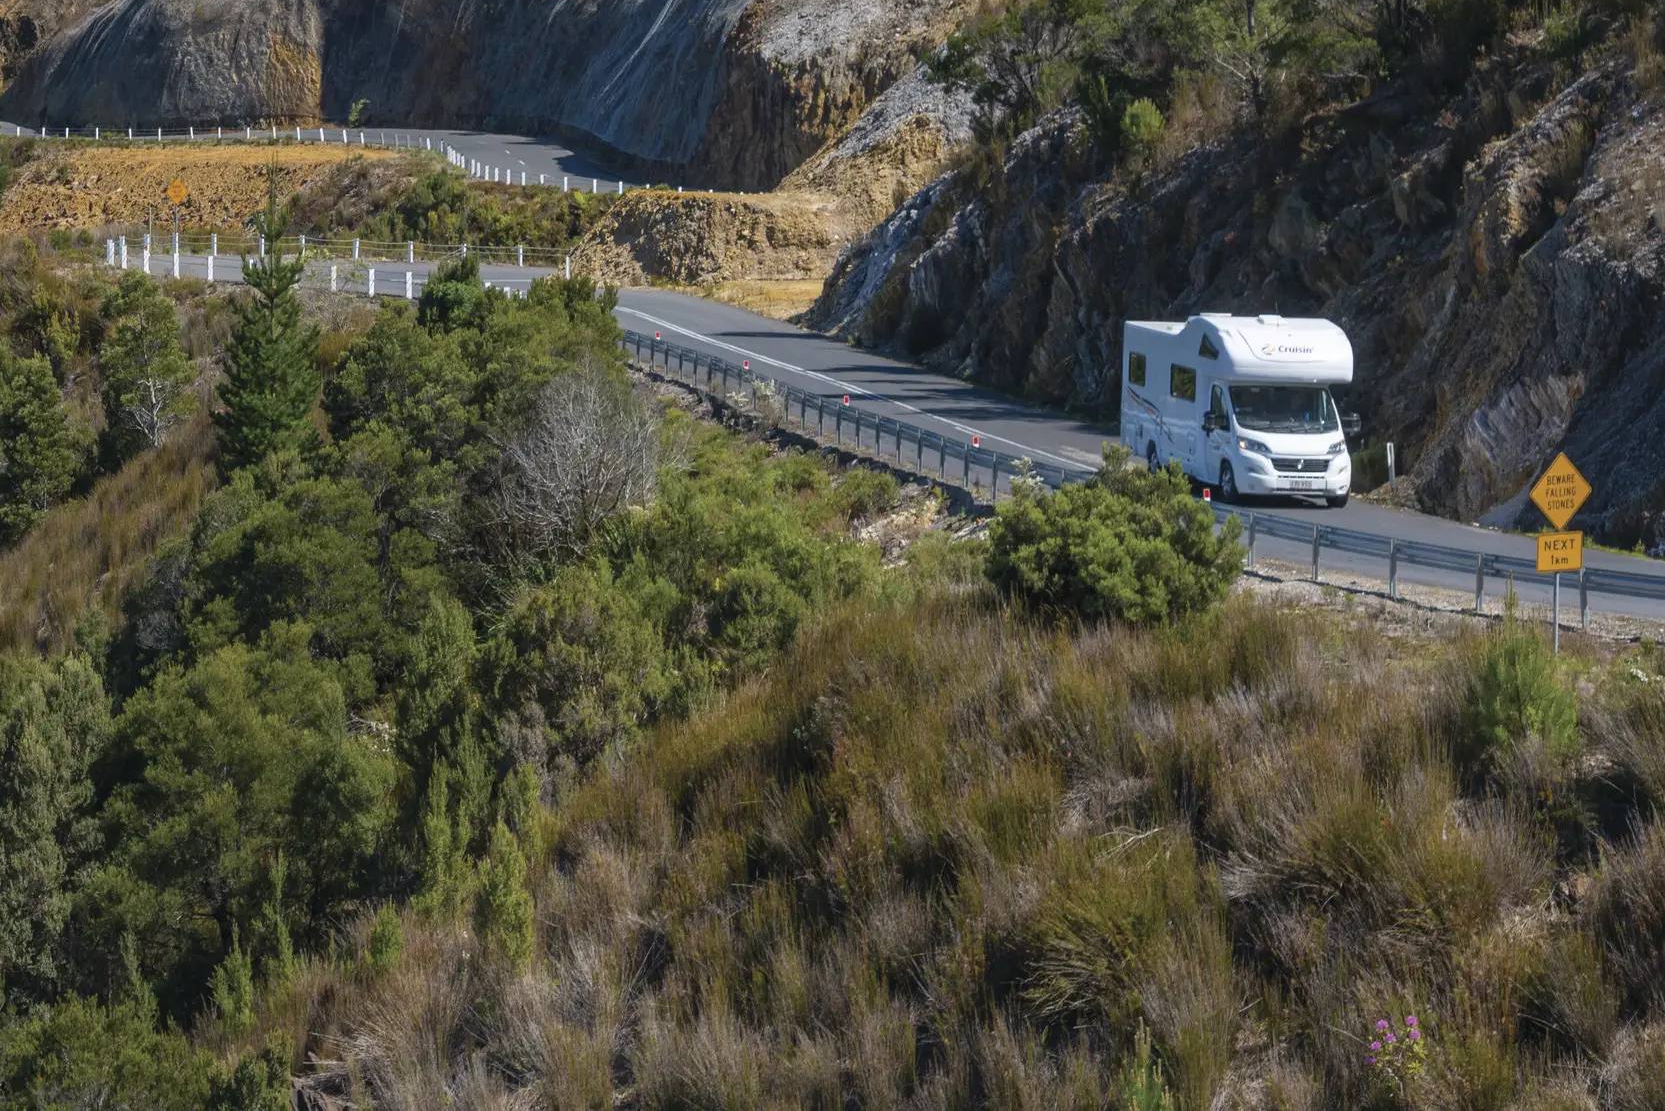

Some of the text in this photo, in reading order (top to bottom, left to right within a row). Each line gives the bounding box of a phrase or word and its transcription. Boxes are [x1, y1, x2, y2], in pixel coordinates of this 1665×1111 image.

[1547, 474, 1575, 486] BEWARE
[1546, 487, 1576, 498] FALLING
[1548, 498, 1574, 511] STONES
[1544, 539, 1575, 551] NEXT
